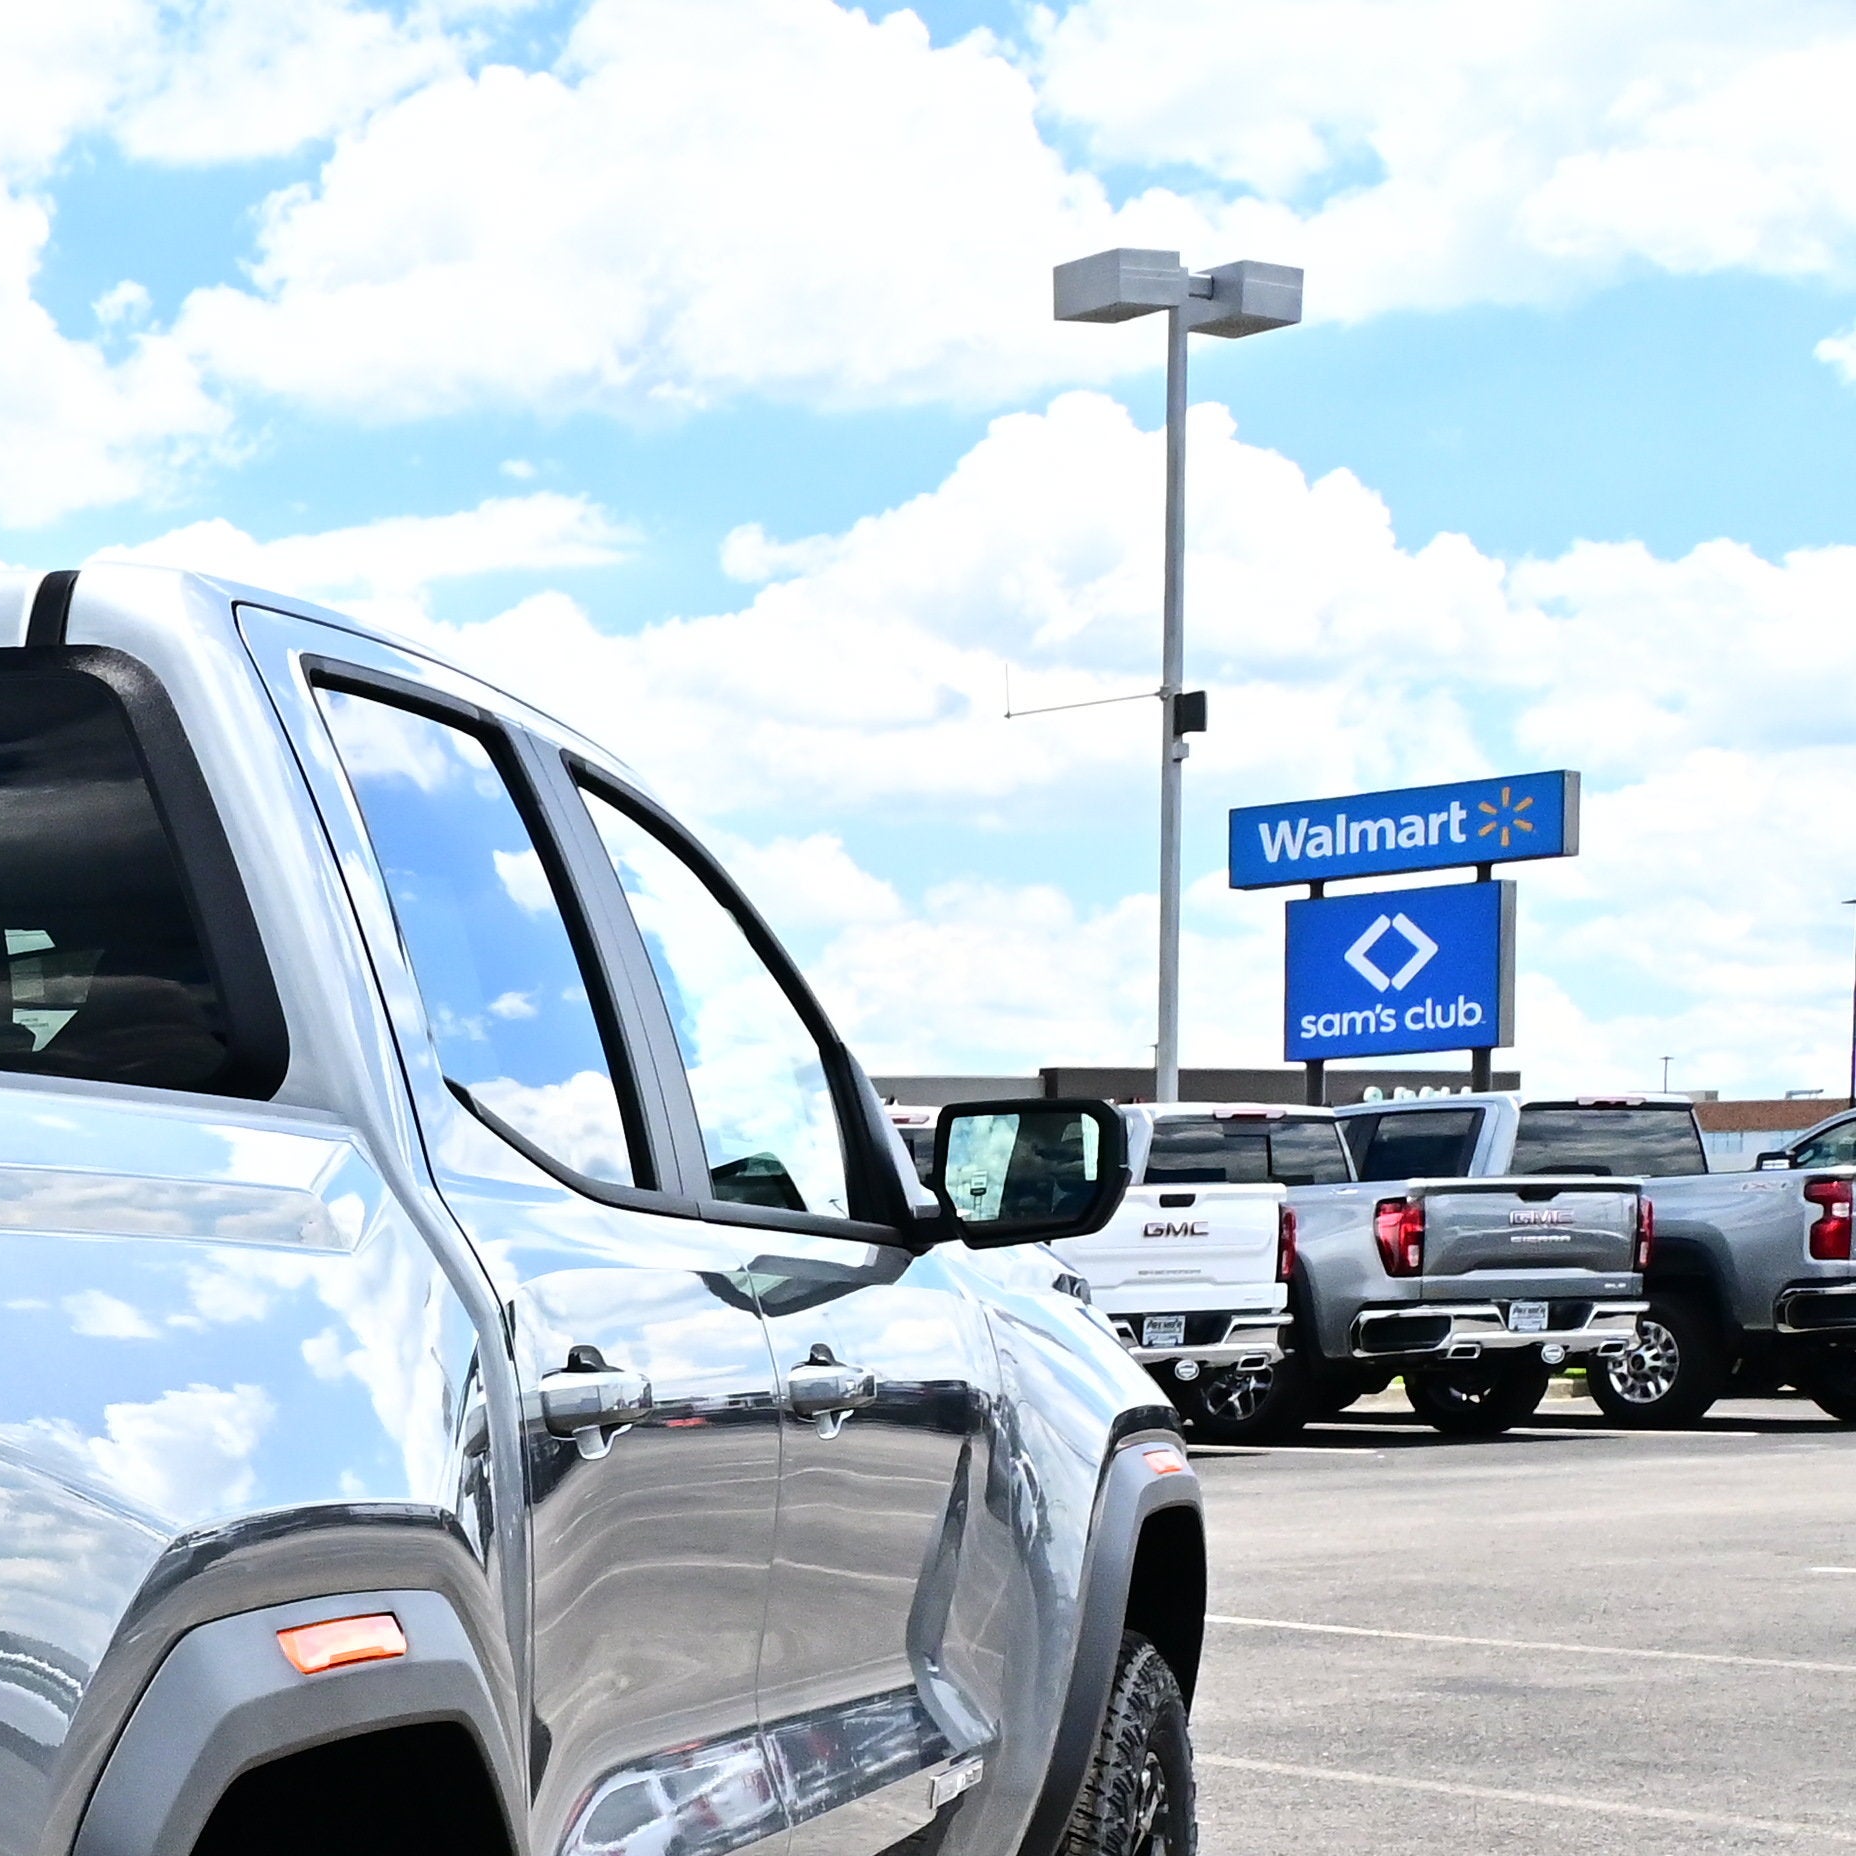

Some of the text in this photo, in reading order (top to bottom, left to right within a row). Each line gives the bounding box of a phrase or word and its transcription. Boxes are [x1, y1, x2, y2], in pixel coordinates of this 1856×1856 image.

[1259, 801, 1467, 863] Walmart
[1300, 995, 1482, 1038] sam's club
[1144, 1221, 1209, 1238] GMC
[1510, 1209, 1575, 1225] GMC
